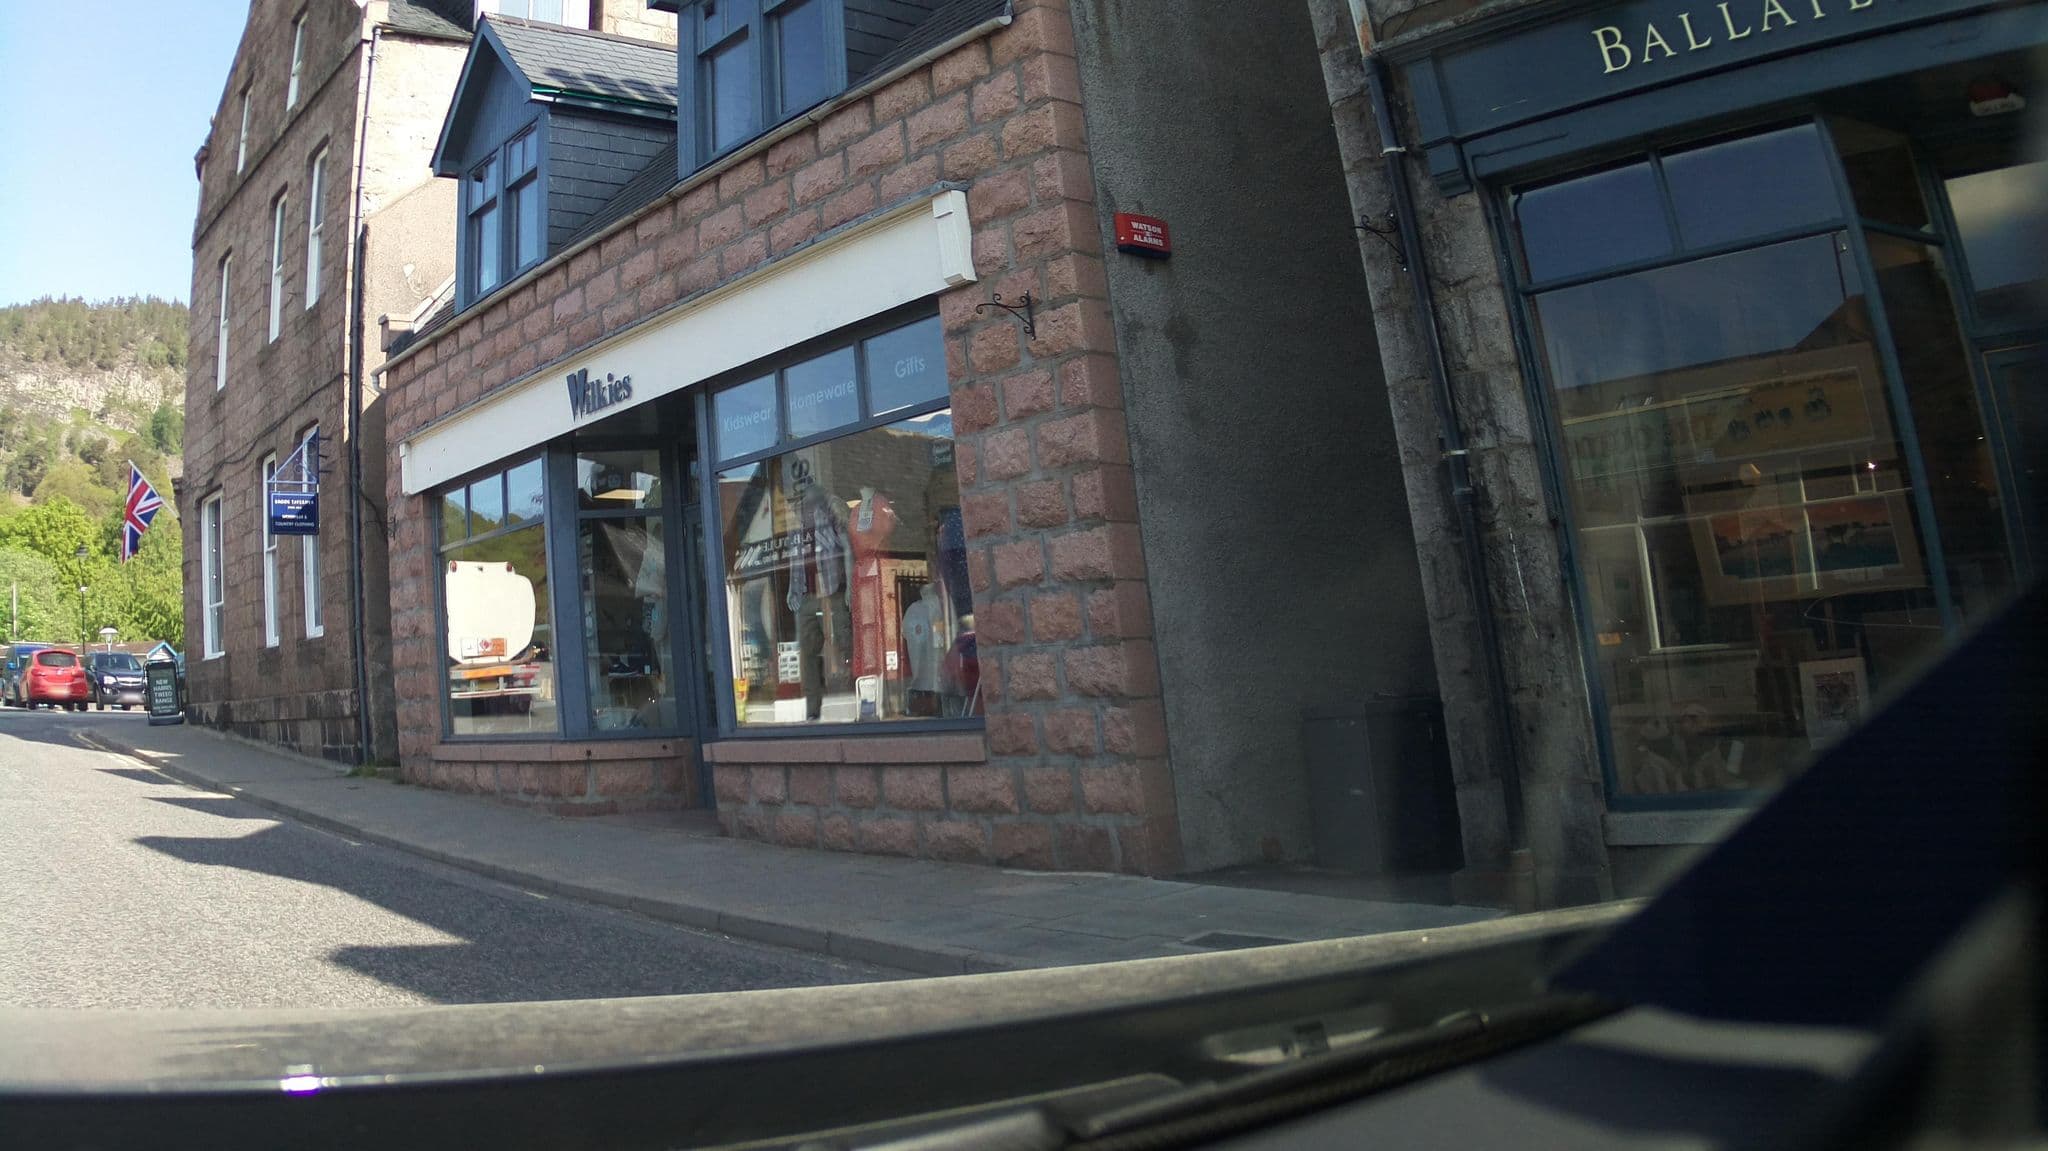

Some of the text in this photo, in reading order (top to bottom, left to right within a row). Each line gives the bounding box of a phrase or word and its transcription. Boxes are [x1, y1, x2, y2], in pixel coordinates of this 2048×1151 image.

[1130, 221, 1162, 234] WATSON
[1133, 234, 1164, 247] ALARMS
[895, 356, 926, 378] Gifts
[566, 368, 633, 423] Wilkies
[790, 381, 856, 409] Homeware
[723, 407, 772, 432] Kidswear
